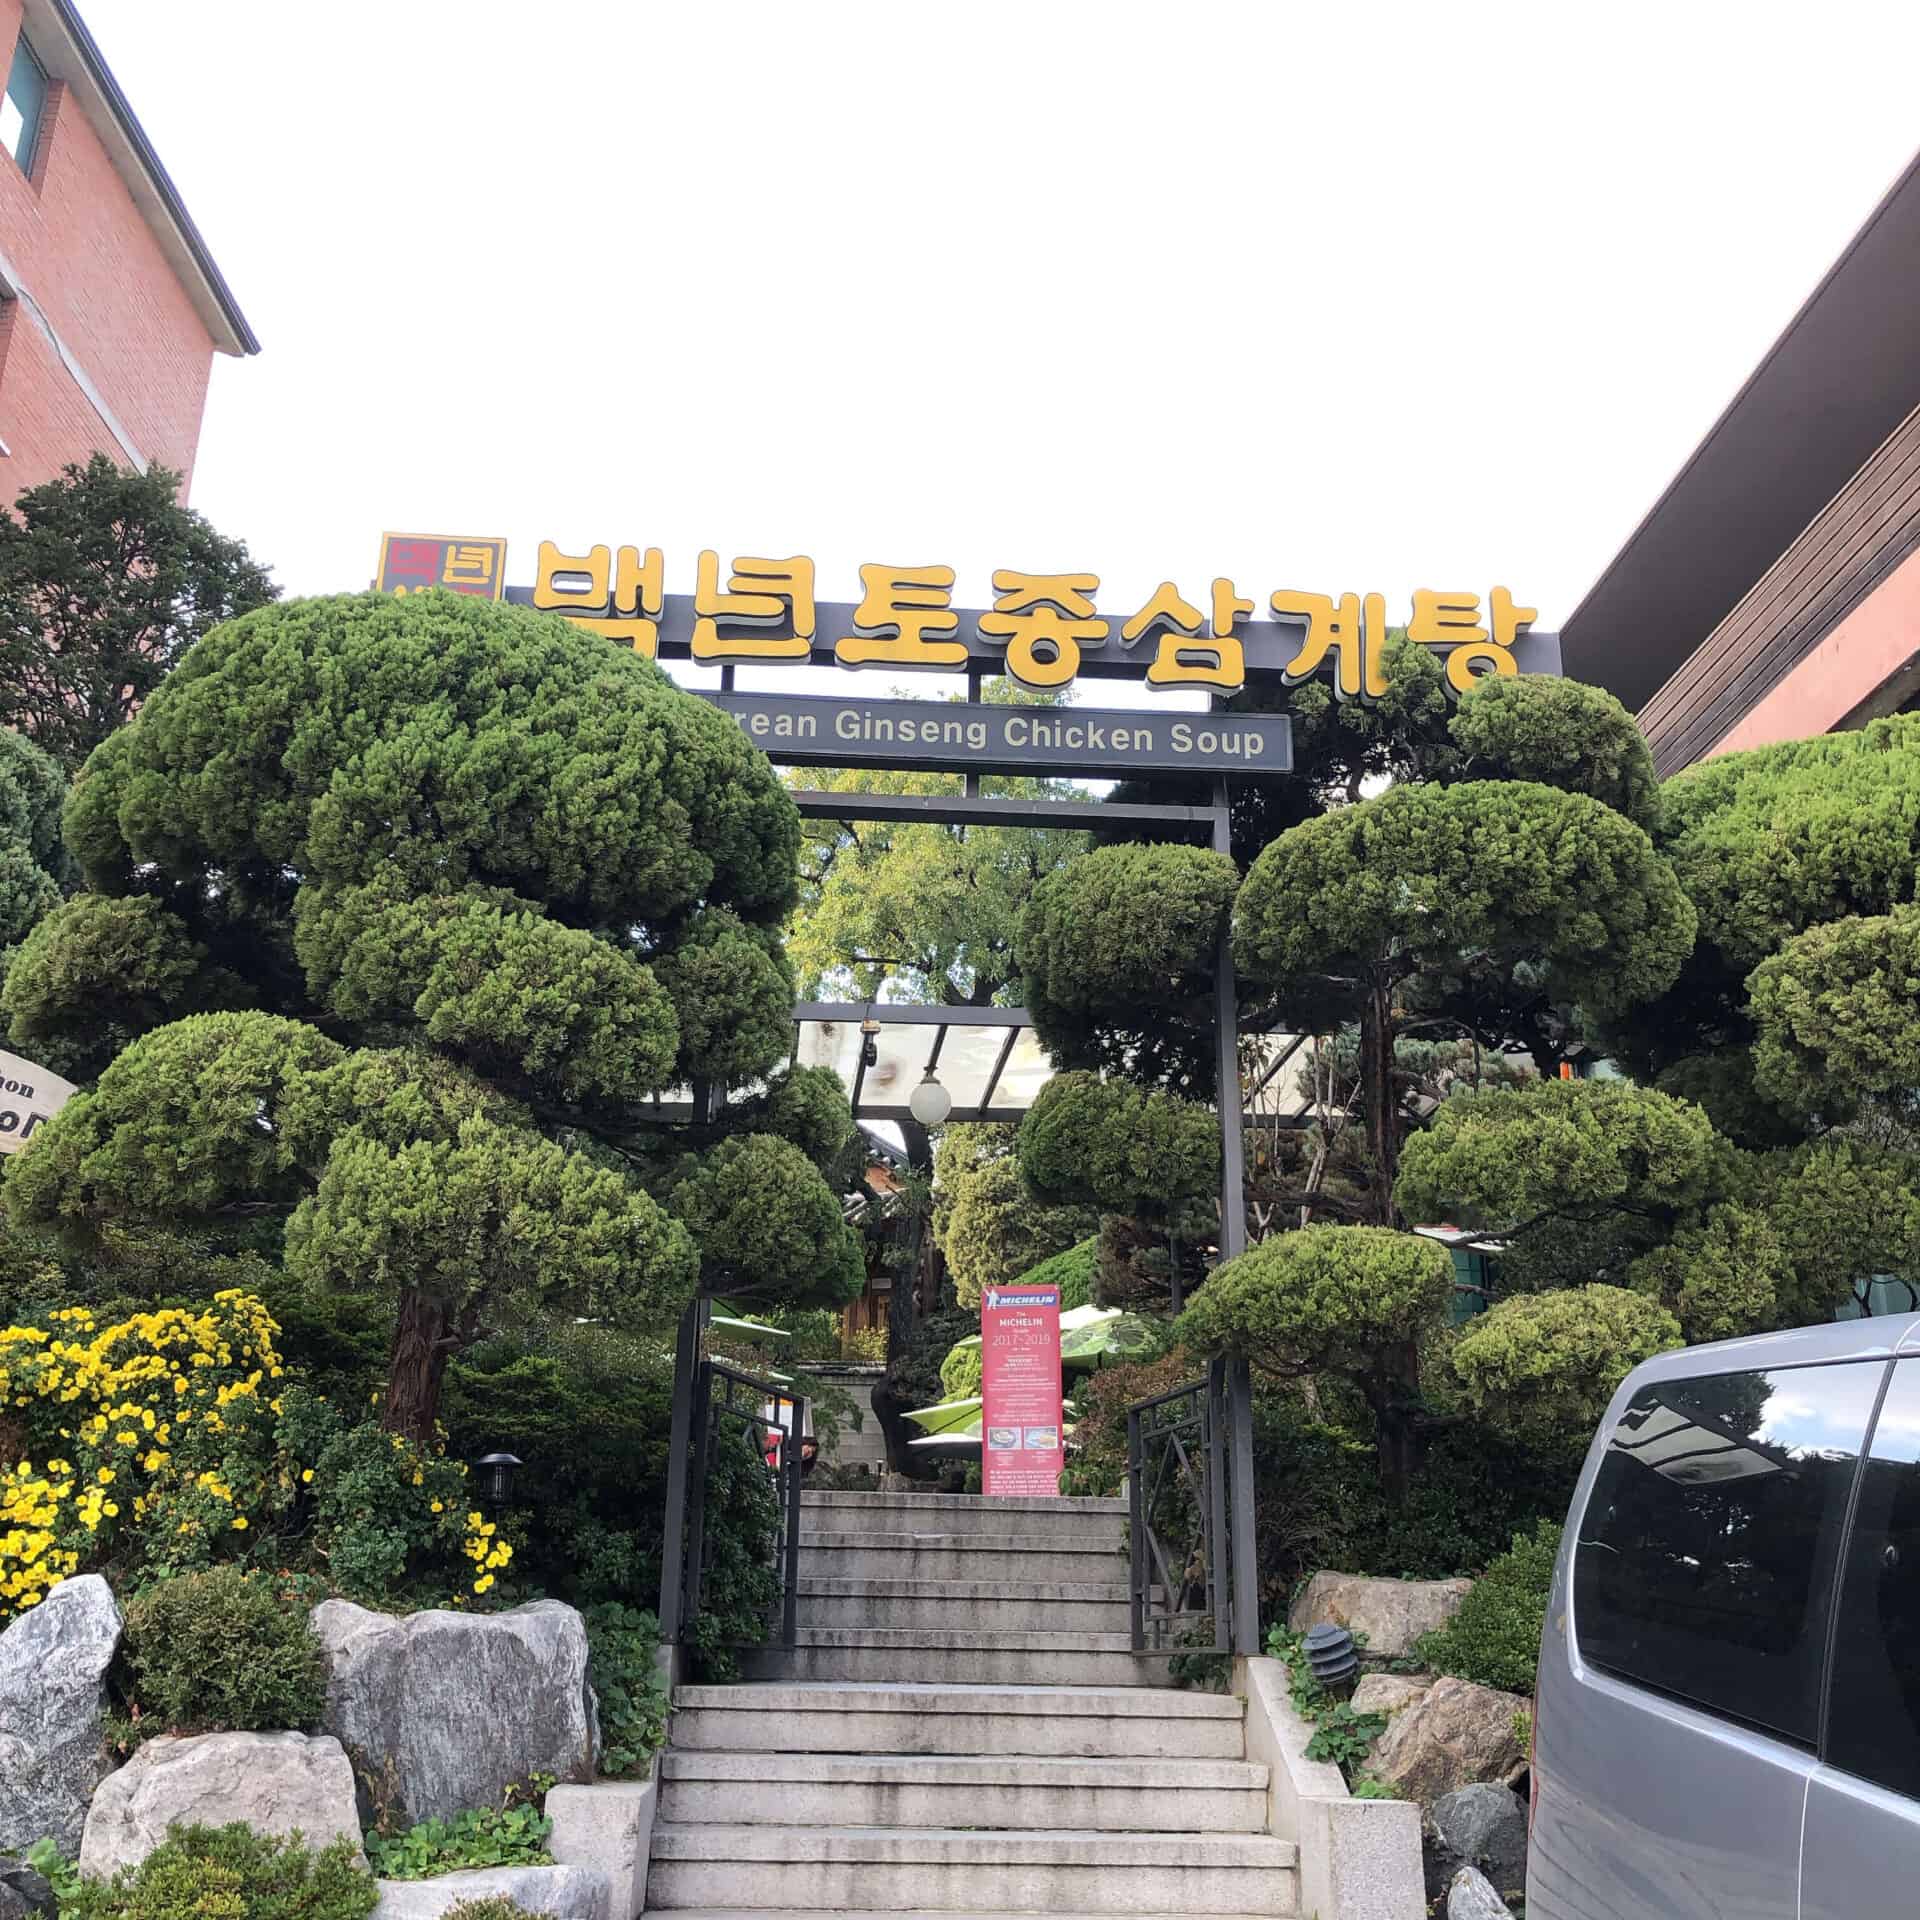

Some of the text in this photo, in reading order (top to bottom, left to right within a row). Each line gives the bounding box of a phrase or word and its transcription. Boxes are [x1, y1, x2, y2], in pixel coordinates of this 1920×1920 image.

[835, 710, 986, 750] Ginseng
[1004, 716, 1154, 752] Chicken
[1171, 722, 1264, 760] Soup
[999, 1295, 1055, 1305] MICHELIN
[999, 1317, 1043, 1327] MICHELIN
